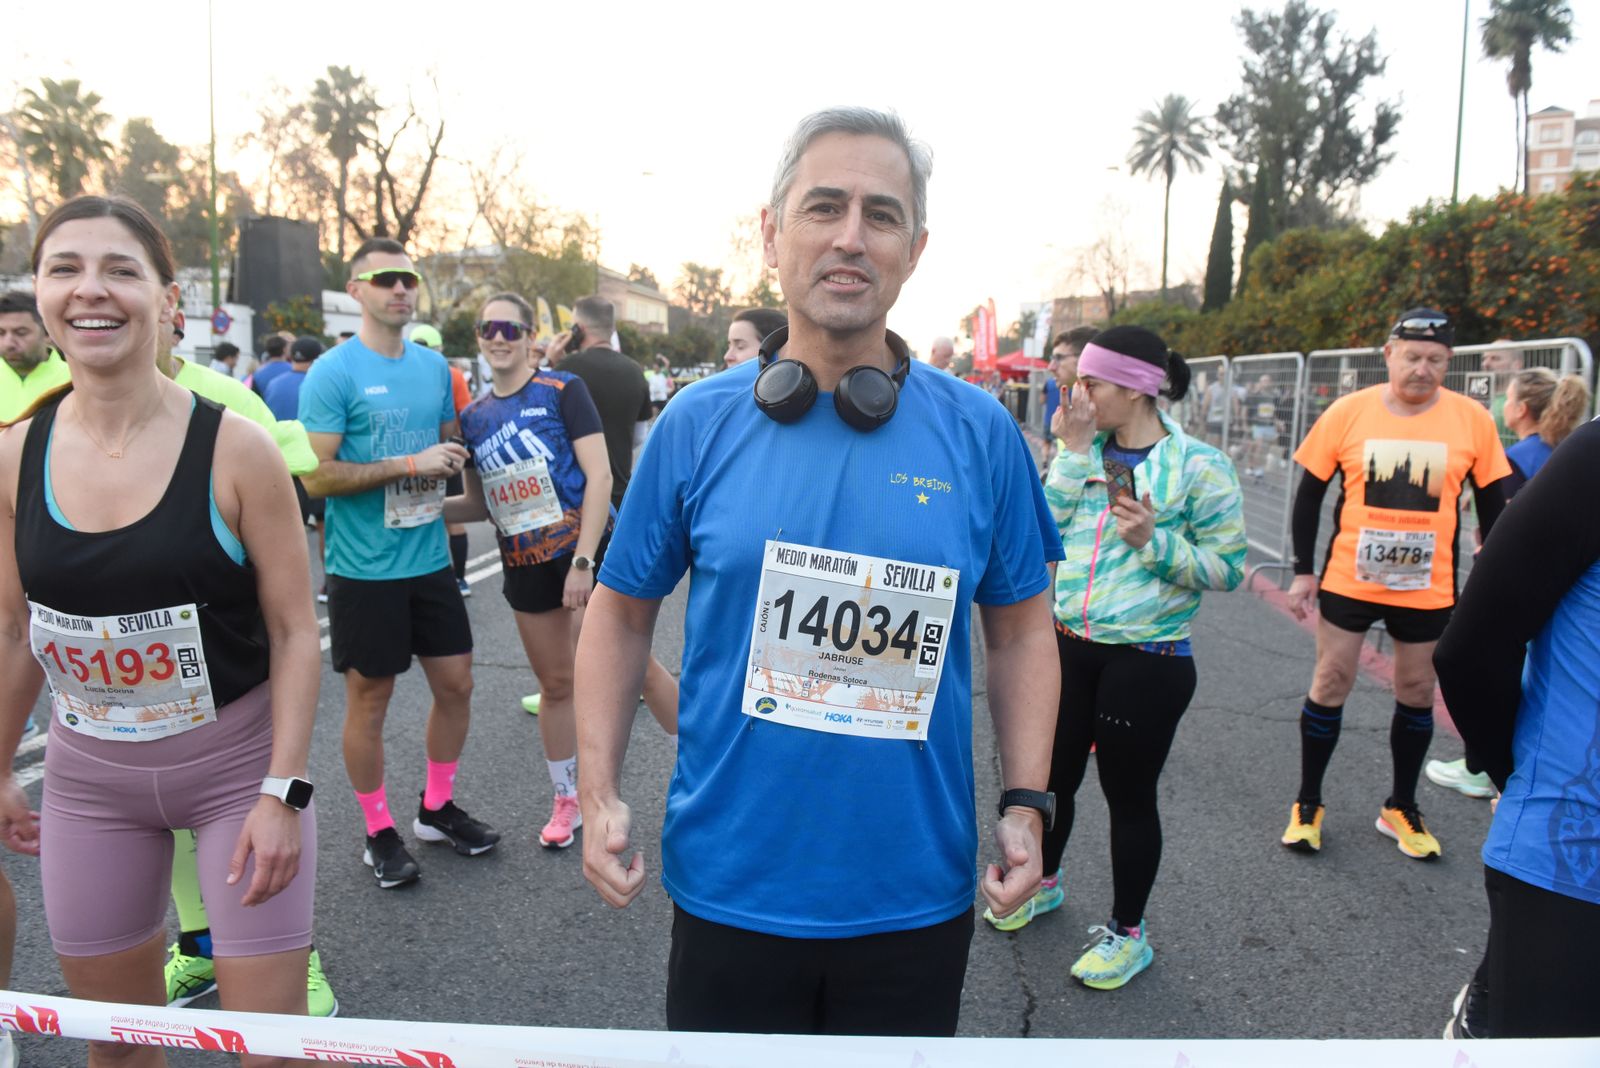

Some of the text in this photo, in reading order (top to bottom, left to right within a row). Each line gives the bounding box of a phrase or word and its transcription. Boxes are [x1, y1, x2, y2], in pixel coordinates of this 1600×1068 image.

[368, 408, 410, 434] FLY
[520, 407, 547, 418] HOKA
[489, 475, 541, 507] 14188
[890, 473, 952, 493] LOS BREIDYS
[776, 547, 858, 577] MEDIO MARATÓN
[1365, 544, 1422, 564] 13478
[883, 563, 937, 592] SEVILLA
[37, 606, 94, 632] MEDIO MARATÓN
[118, 610, 173, 634] SEVILLA
[760, 607, 770, 633] CAJÓN
[774, 589, 920, 660] 14034
[44, 641, 175, 686] 15193
[818, 652, 864, 665] JABRUSE
[808, 670, 840, 681] Rodenas
[824, 712, 852, 724] HOKA
[113, 726, 137, 734] HOKA
[111, 1016, 192, 1033] Acción Creativa de Eventos
[301, 1037, 392, 1054] Acción Creativa de Eventos
